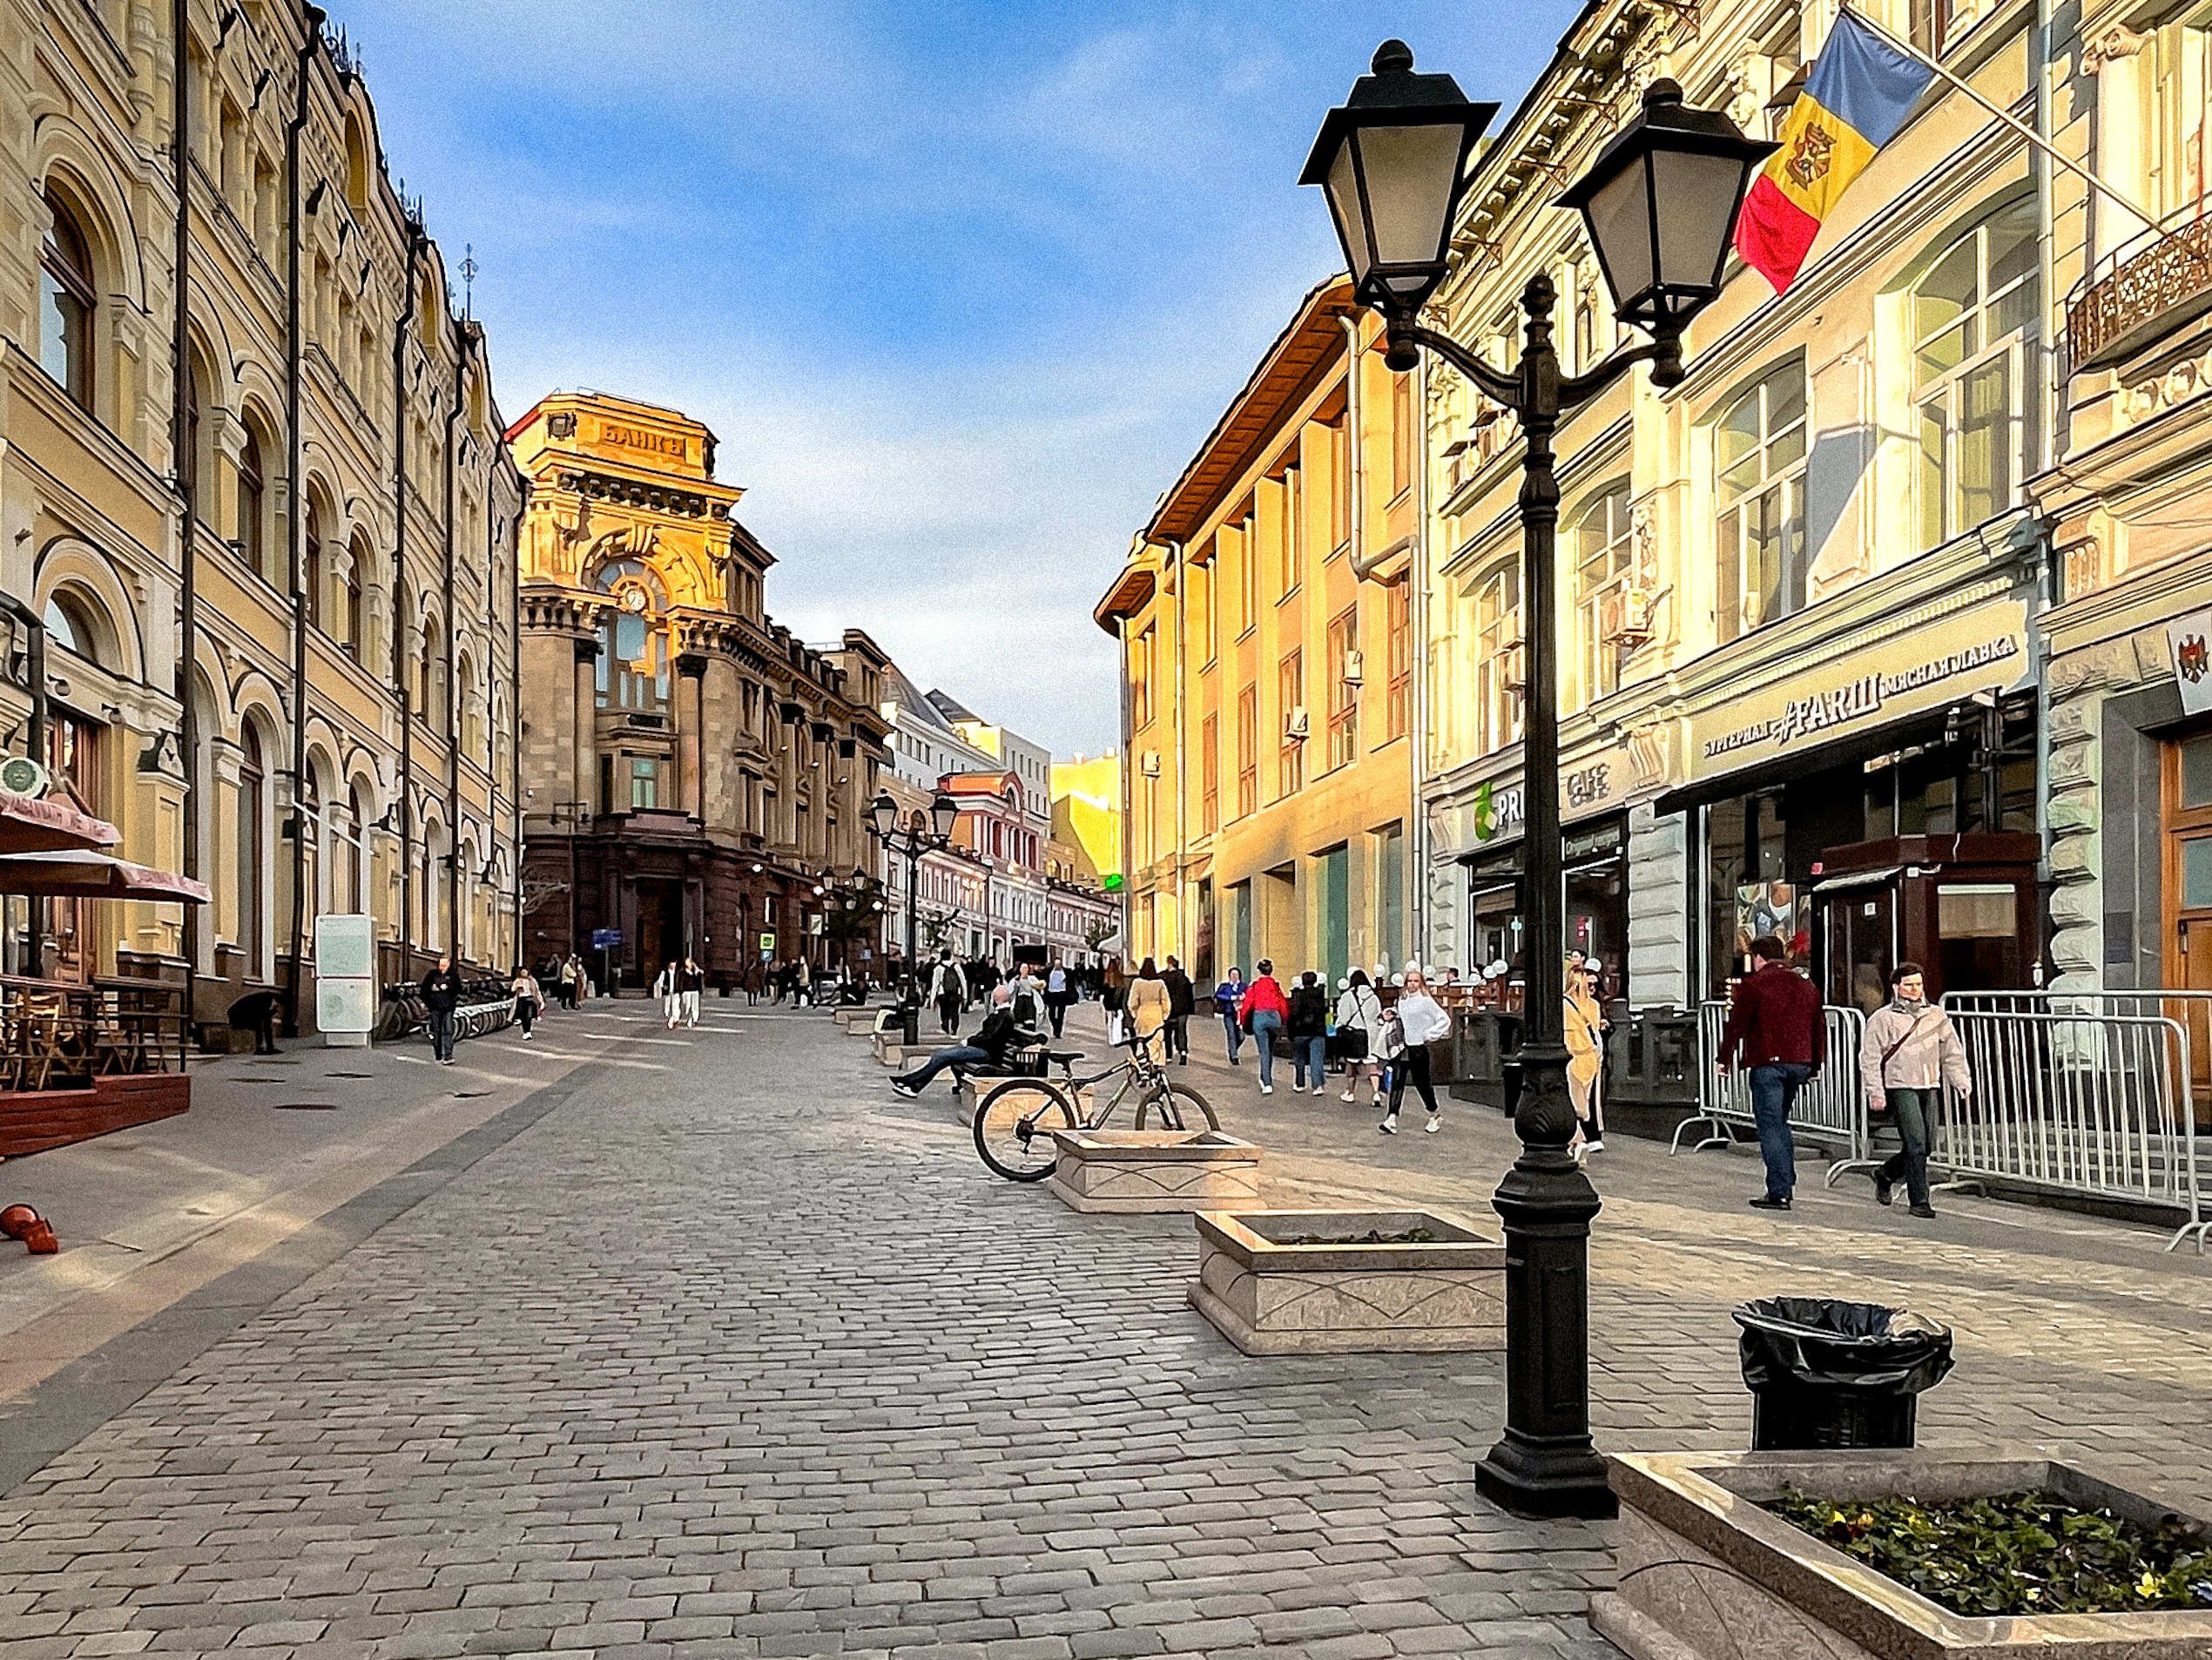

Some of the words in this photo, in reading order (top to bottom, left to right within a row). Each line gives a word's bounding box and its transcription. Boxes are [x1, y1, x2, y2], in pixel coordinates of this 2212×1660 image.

[1879, 658, 1951, 697] МЯСНАЯ
[1950, 635, 2019, 672] ЛАВКА
[1498, 785, 1525, 826] PRI
[1568, 764, 1610, 808] CAFE
